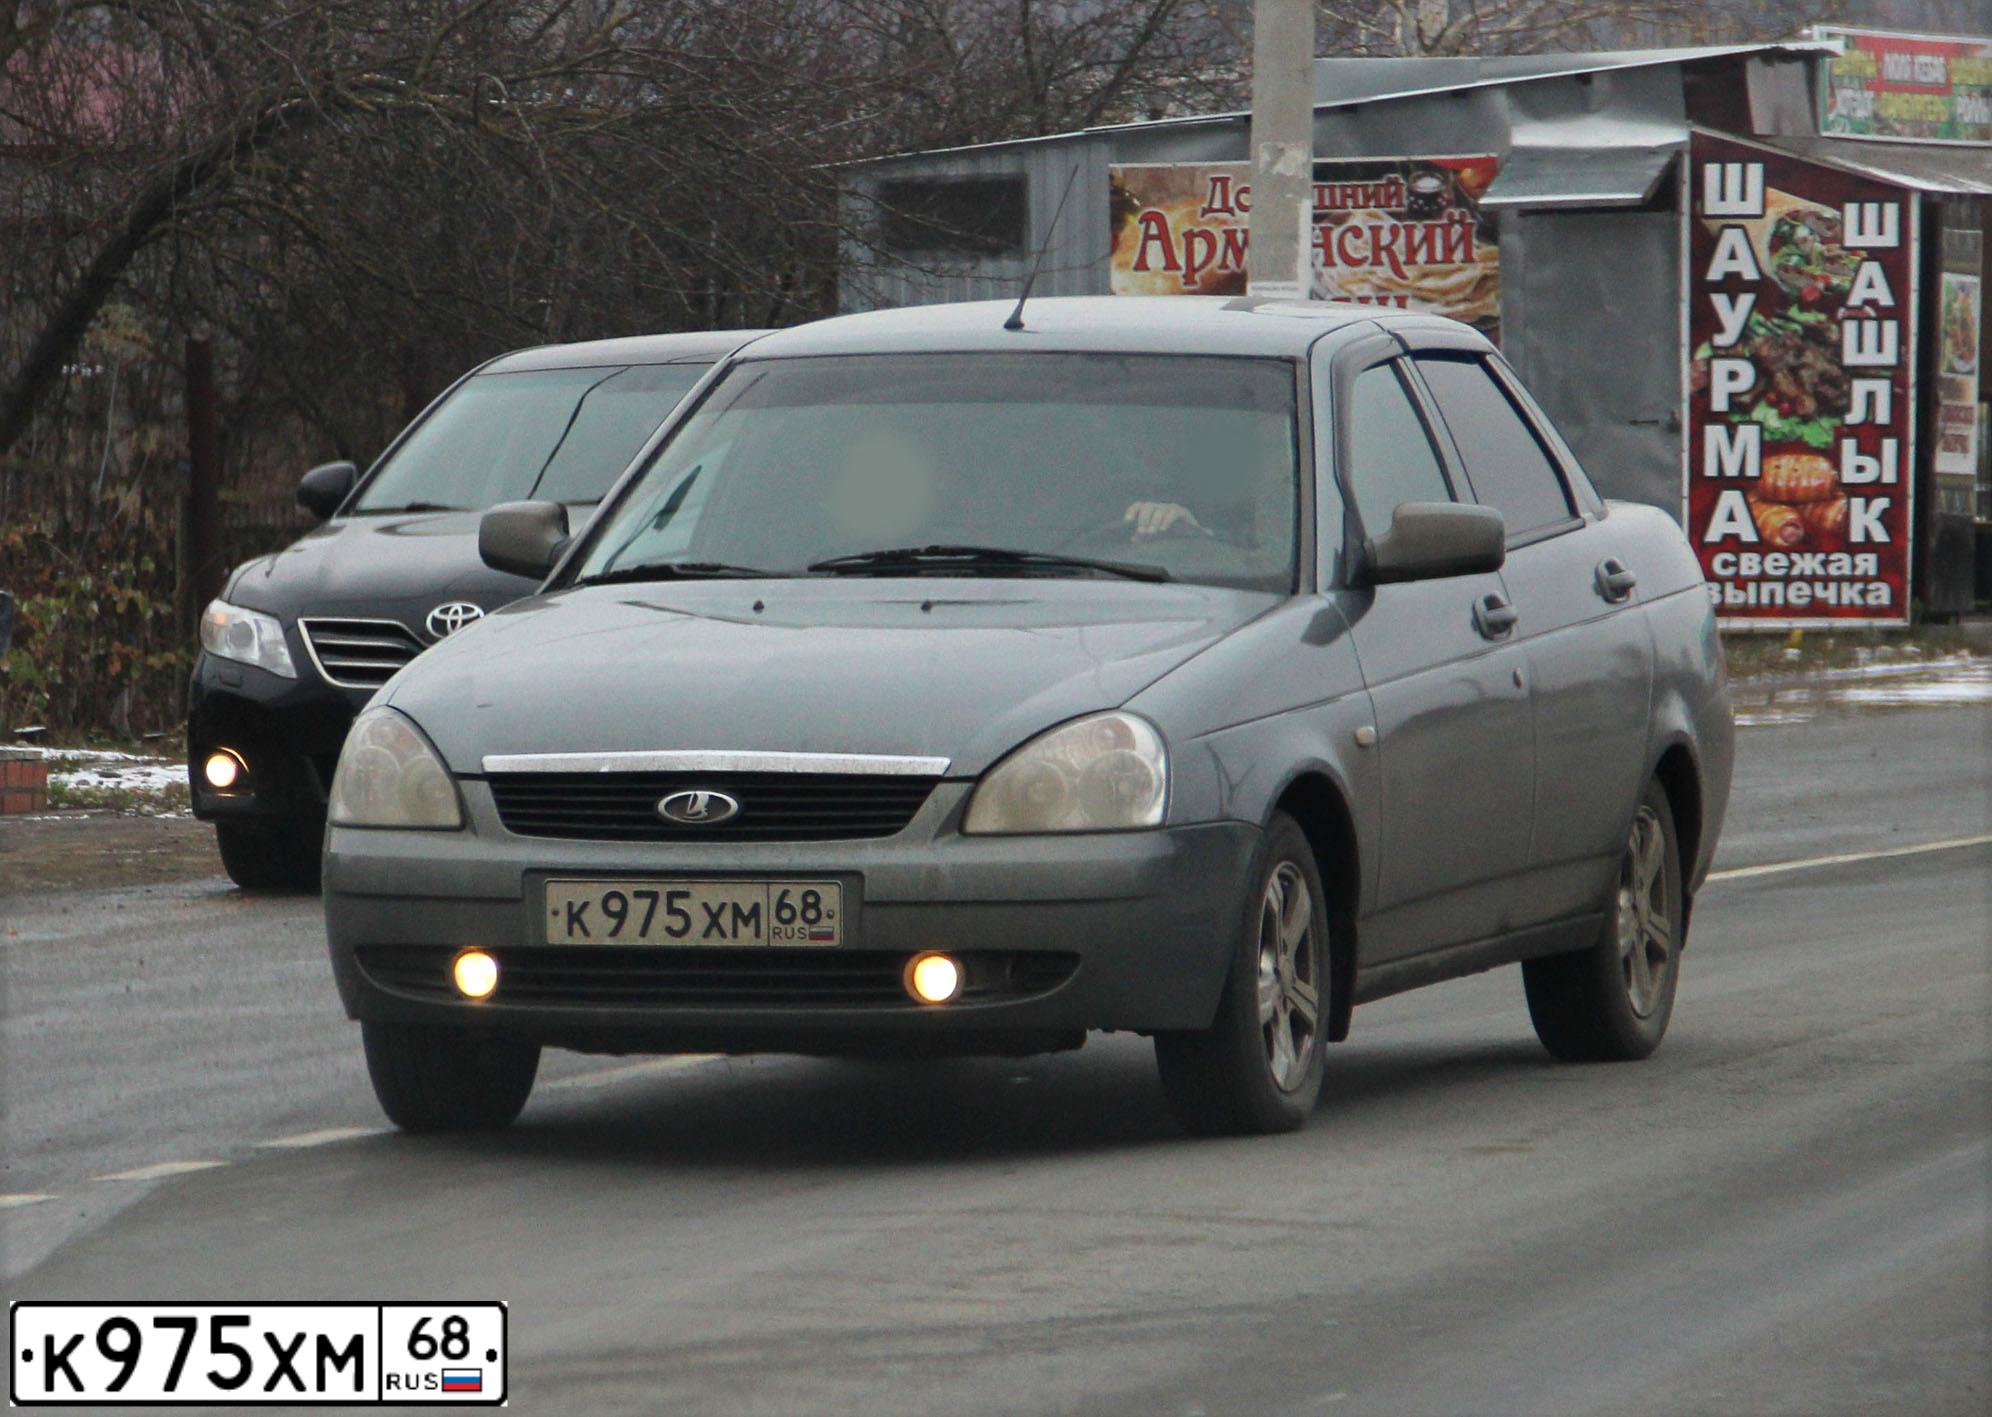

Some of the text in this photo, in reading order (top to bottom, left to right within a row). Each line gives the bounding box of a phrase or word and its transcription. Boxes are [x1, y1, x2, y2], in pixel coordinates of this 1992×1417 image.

[1133, 210, 1476, 286] Армнский
[1703, 162, 1765, 543] ШАУРМА
[1841, 202, 1899, 543] ШАШЛЫК
[1711, 551, 1879, 577] свежая
[566, 888, 823, 938] К975ХМ 68
[771, 926, 807, 940] RUS
